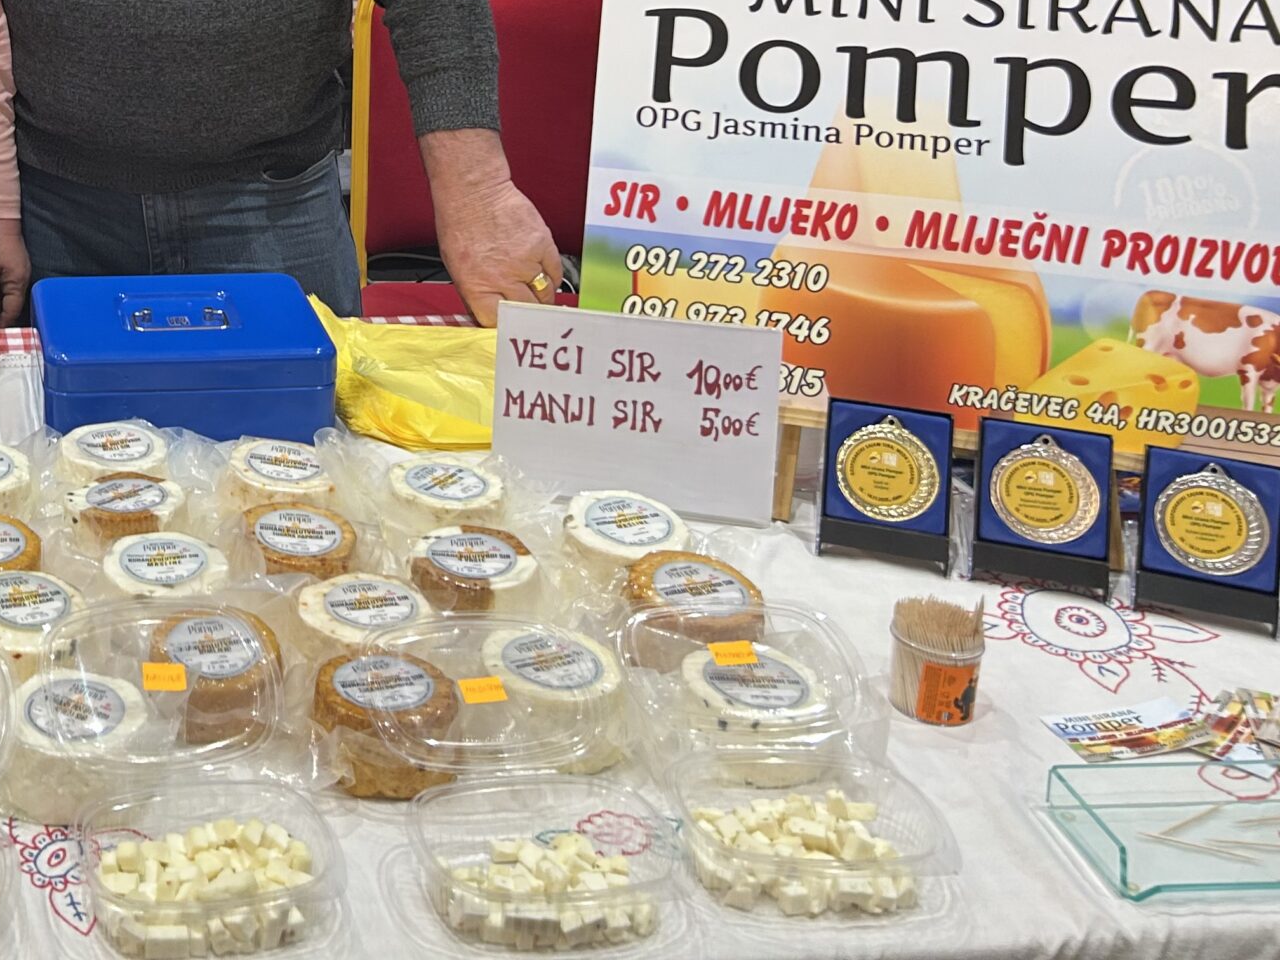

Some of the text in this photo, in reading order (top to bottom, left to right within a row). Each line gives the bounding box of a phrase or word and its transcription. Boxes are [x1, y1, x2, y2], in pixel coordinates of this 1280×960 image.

[645, 7, 1280, 166] Pomper
[636, 106, 990, 159] OPG Jasmina Pomper
[604, 181, 660, 223] SIR
[703, 190, 859, 241] MLIJEKO
[905, 209, 1089, 266] MLIJEČNI
[625, 243, 829, 292] 091 272 2310
[509, 328, 583, 374] VEĆI
[607, 349, 661, 382] SIR
[503, 389, 595, 426] MANJI
[612, 400, 662, 433] SIR
[947, 383, 1080, 419] KRAČEVEC
[1085, 401, 1128, 429] 4A,
[1053, 714, 1144, 734] Pomper
